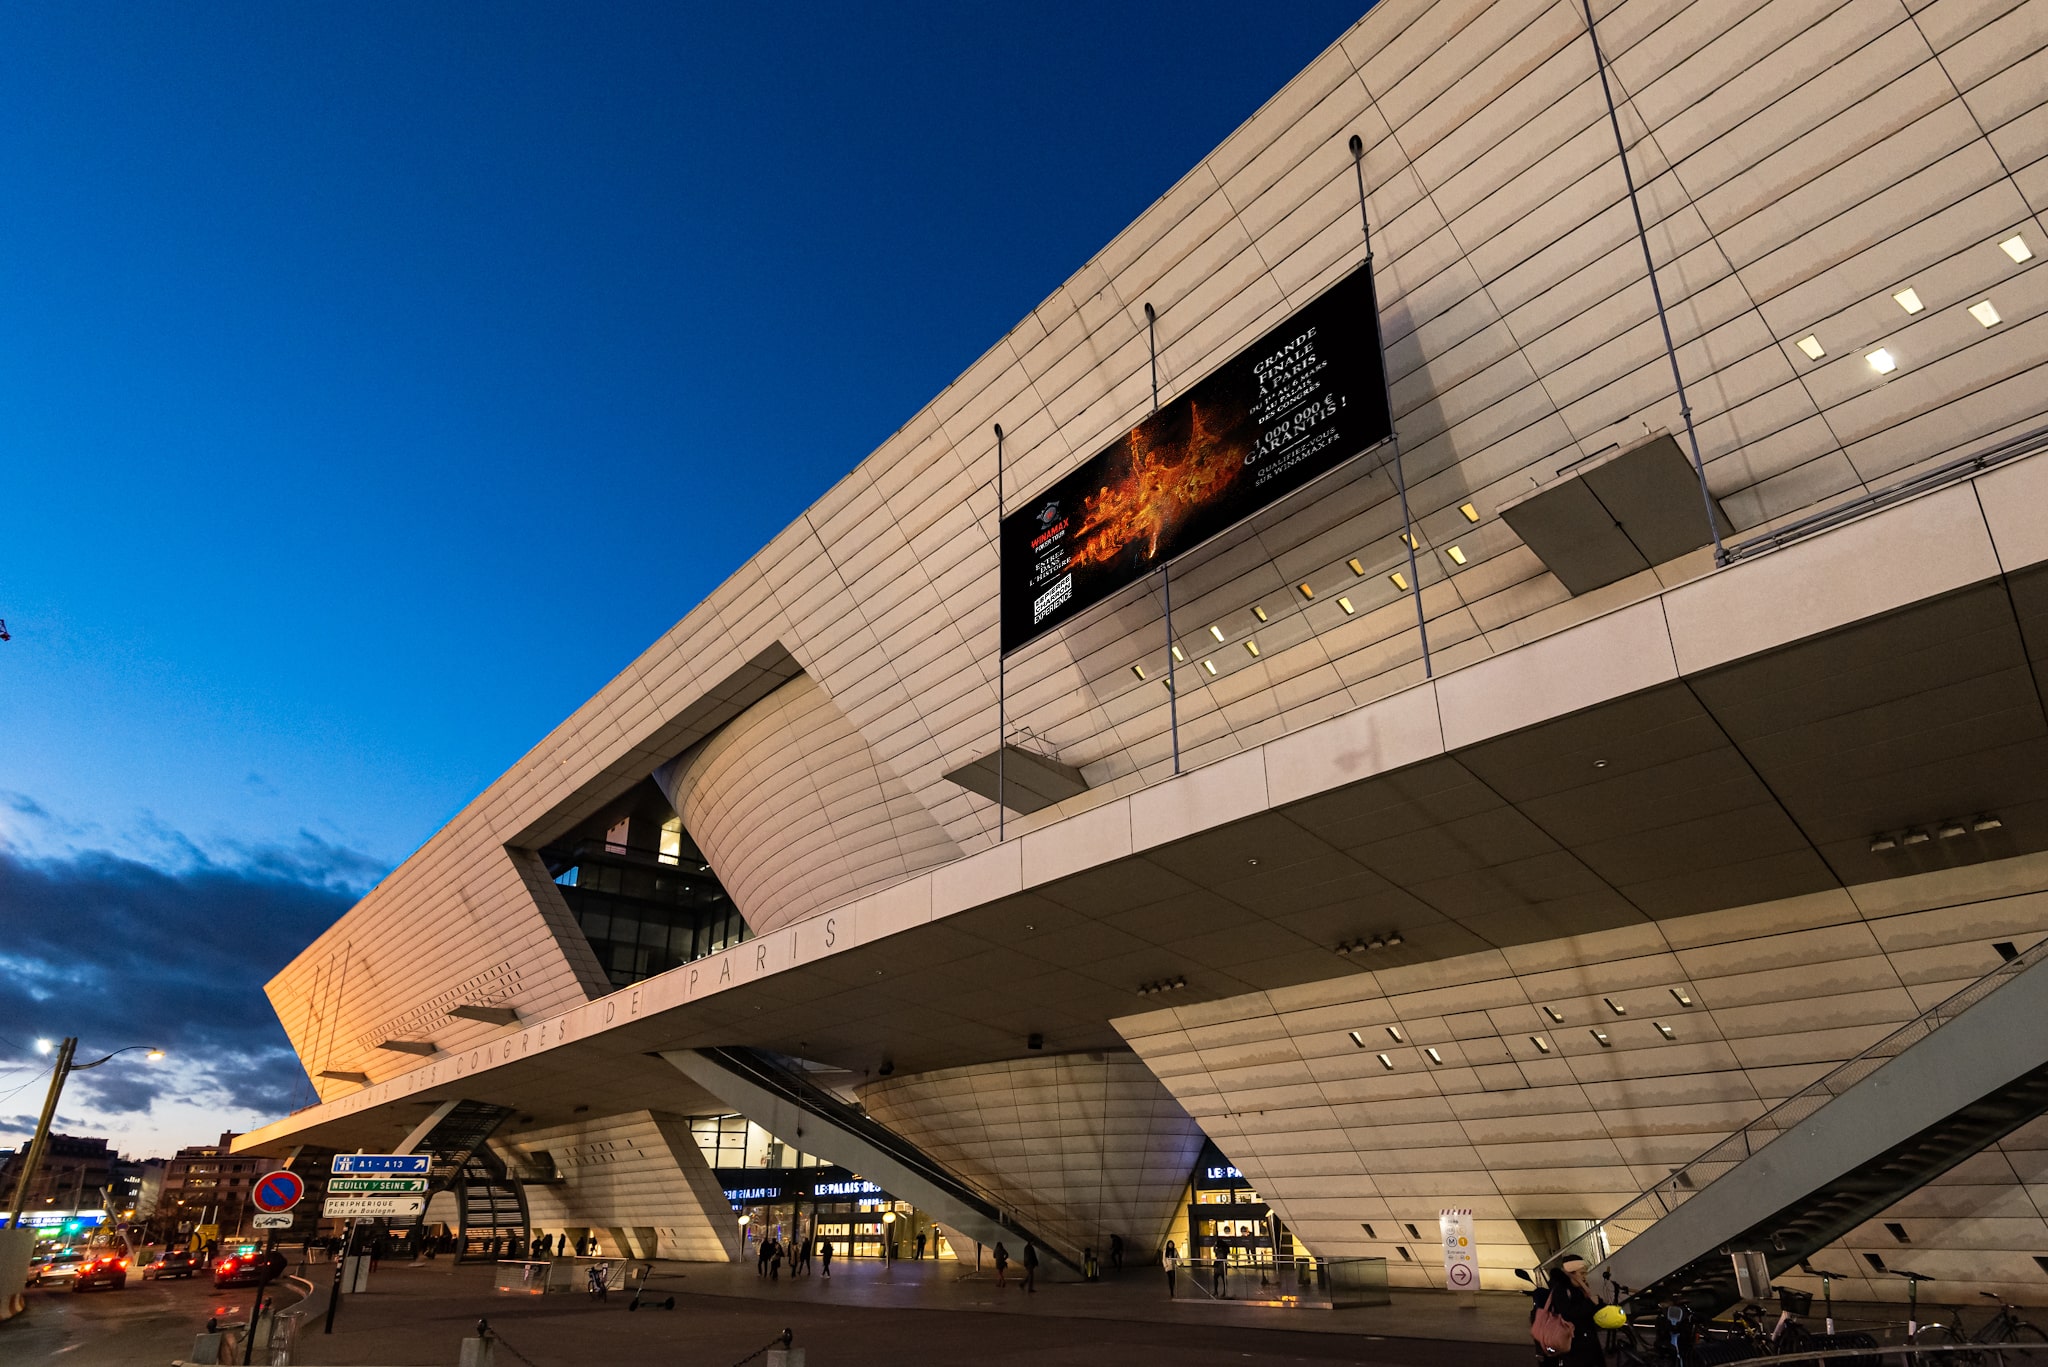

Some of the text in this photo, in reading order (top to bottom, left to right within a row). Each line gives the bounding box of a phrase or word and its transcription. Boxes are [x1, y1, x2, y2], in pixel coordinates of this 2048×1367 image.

[1253, 326, 1317, 374] GRANDE
[1258, 342, 1314, 385] FINALE
[1249, 402, 1262, 415] DU
[1277, 384, 1289, 397] AU
[1300, 360, 1327, 382] MARS
[1258, 353, 1316, 399] À PARIS
[1264, 378, 1312, 413] AU PALAIS
[1243, 402, 1337, 465] GARANTIS
[1253, 393, 1334, 450] 1 000 000 €
[1257, 409, 1275, 425] DES
[1255, 432, 1341, 487] SUR WINAMAX.FR
[1257, 426, 1336, 477] QUALIFIEZ-VOUS
[1031, 517, 1069, 549] WINAMAX
[1035, 529, 1065, 553] POKER TOUR
[1035, 548, 1065, 571] ENTREZ
[1035, 582, 1070, 613] CHARRON
[1045, 575, 1070, 600] PIERRE
[1034, 588, 1072, 625] EXPERIENCE
[408, 1066, 437, 1092] DES
[606, 990, 640, 1025] DE
[690, 918, 836, 995] PARIS
[331, 1181, 369, 1190] NEUILLY
[380, 1181, 406, 1190] SEINE
[815, 1184, 826, 1196] LE
[828, 1182, 860, 1195] PALAIS
[1207, 1167, 1222, 1179] LE
[360, 1208, 397, 1216] Boulogne
